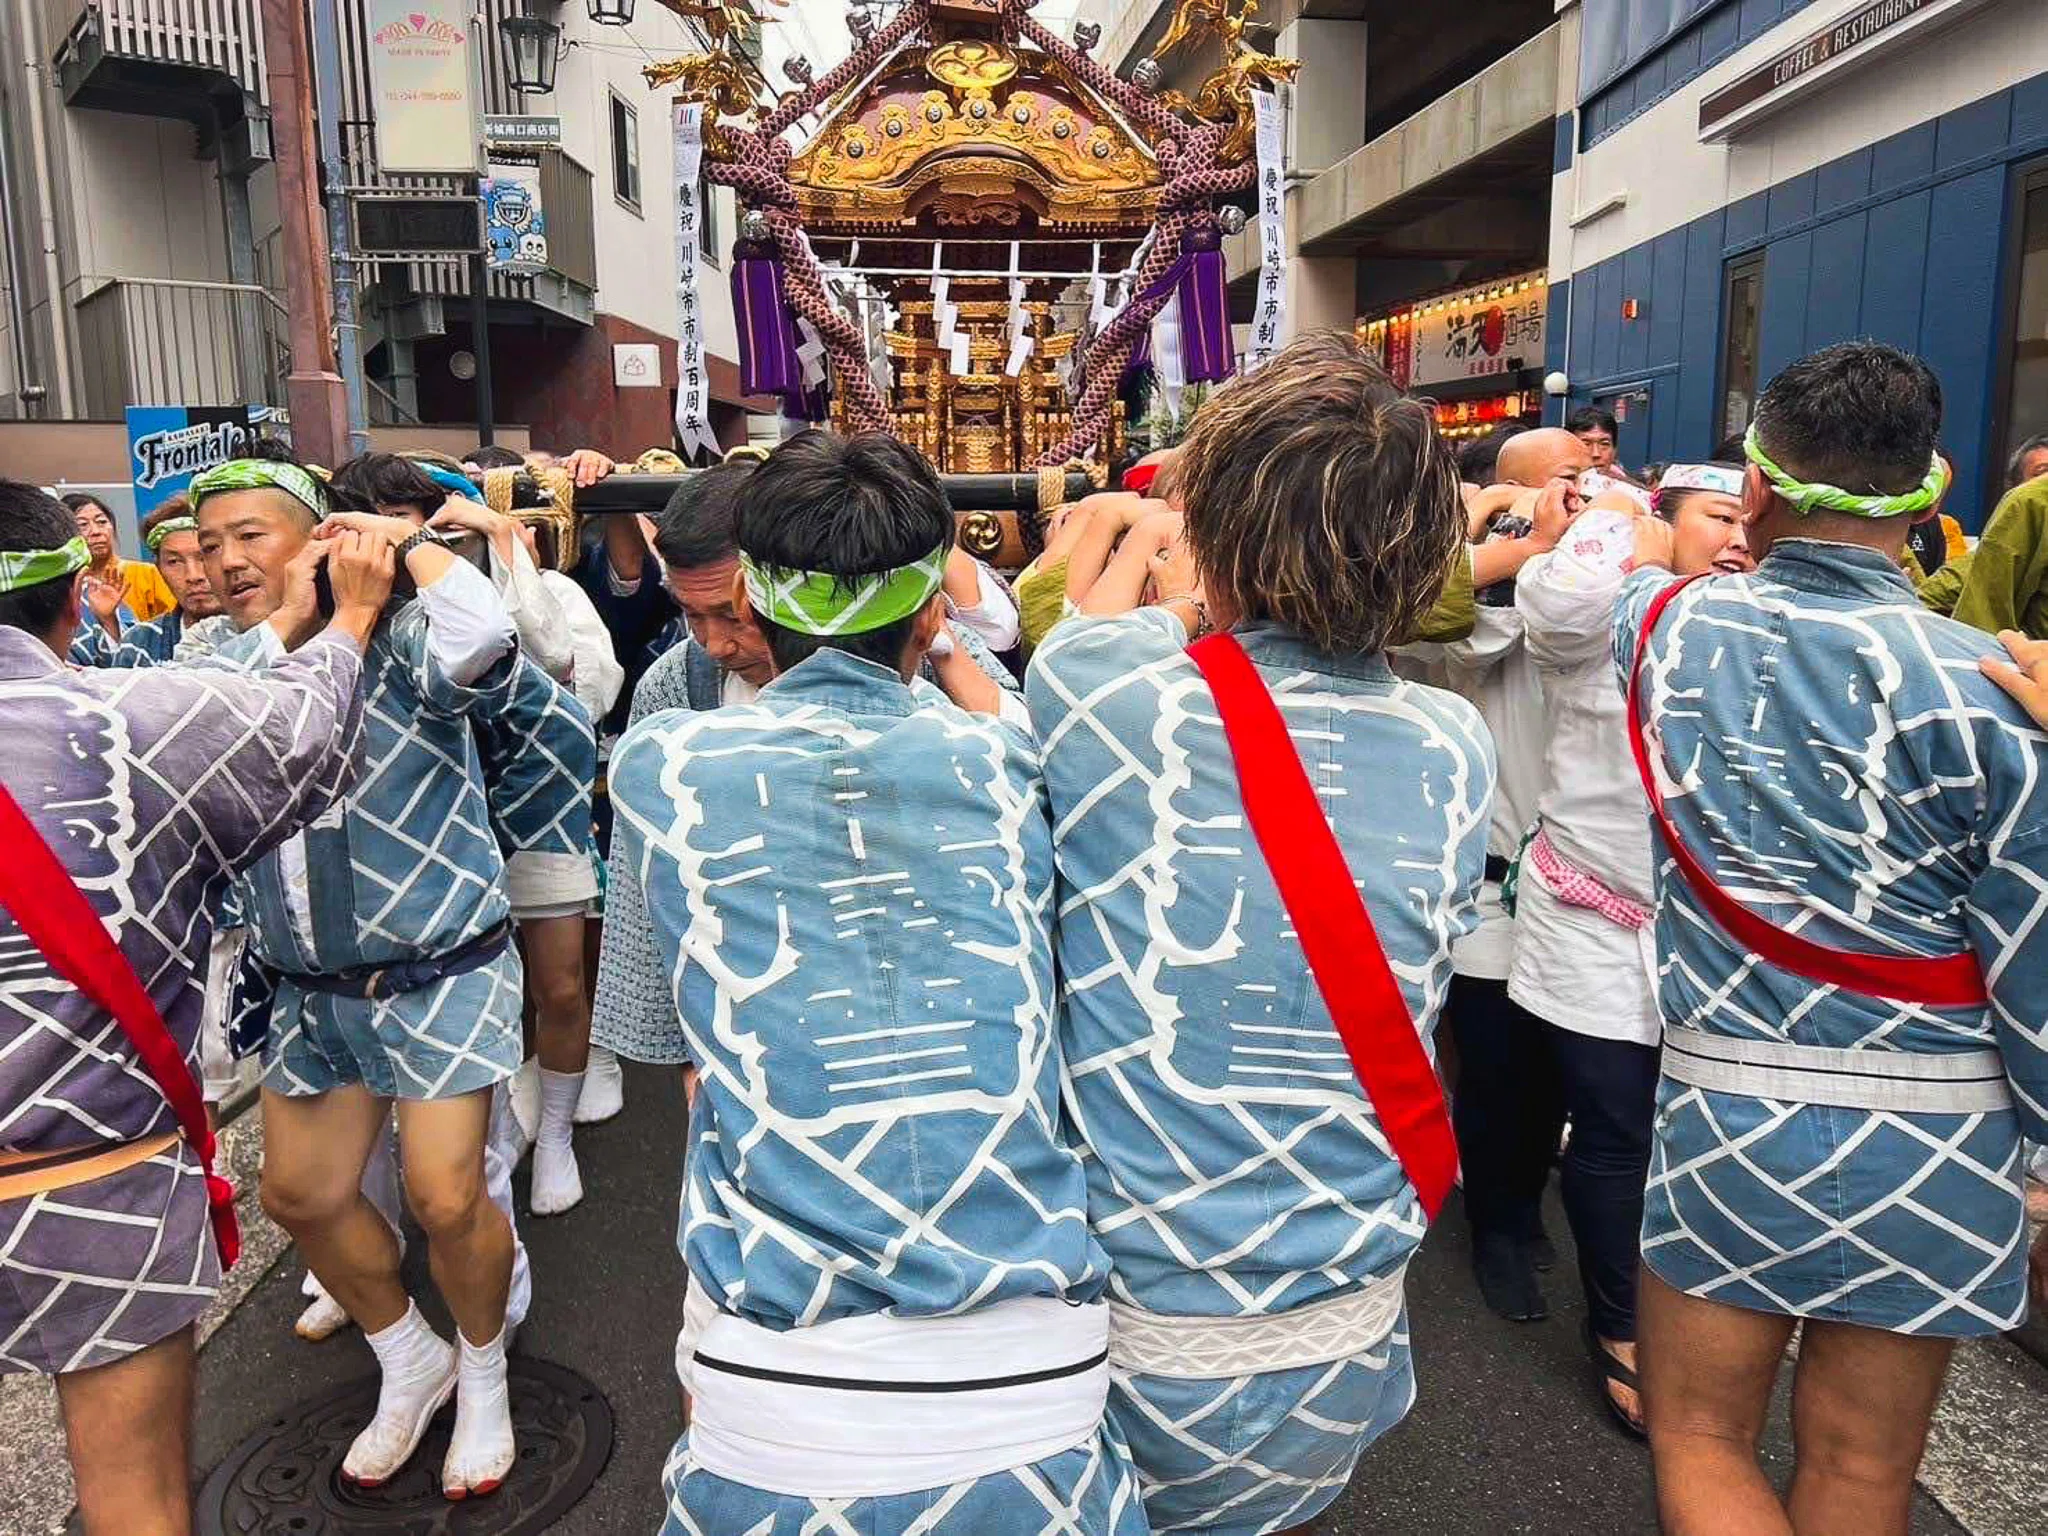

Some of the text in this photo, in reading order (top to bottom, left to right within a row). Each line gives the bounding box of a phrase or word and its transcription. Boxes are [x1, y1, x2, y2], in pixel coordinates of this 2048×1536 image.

[1773, 0, 1921, 85] COFFEE & RESTAURAN
